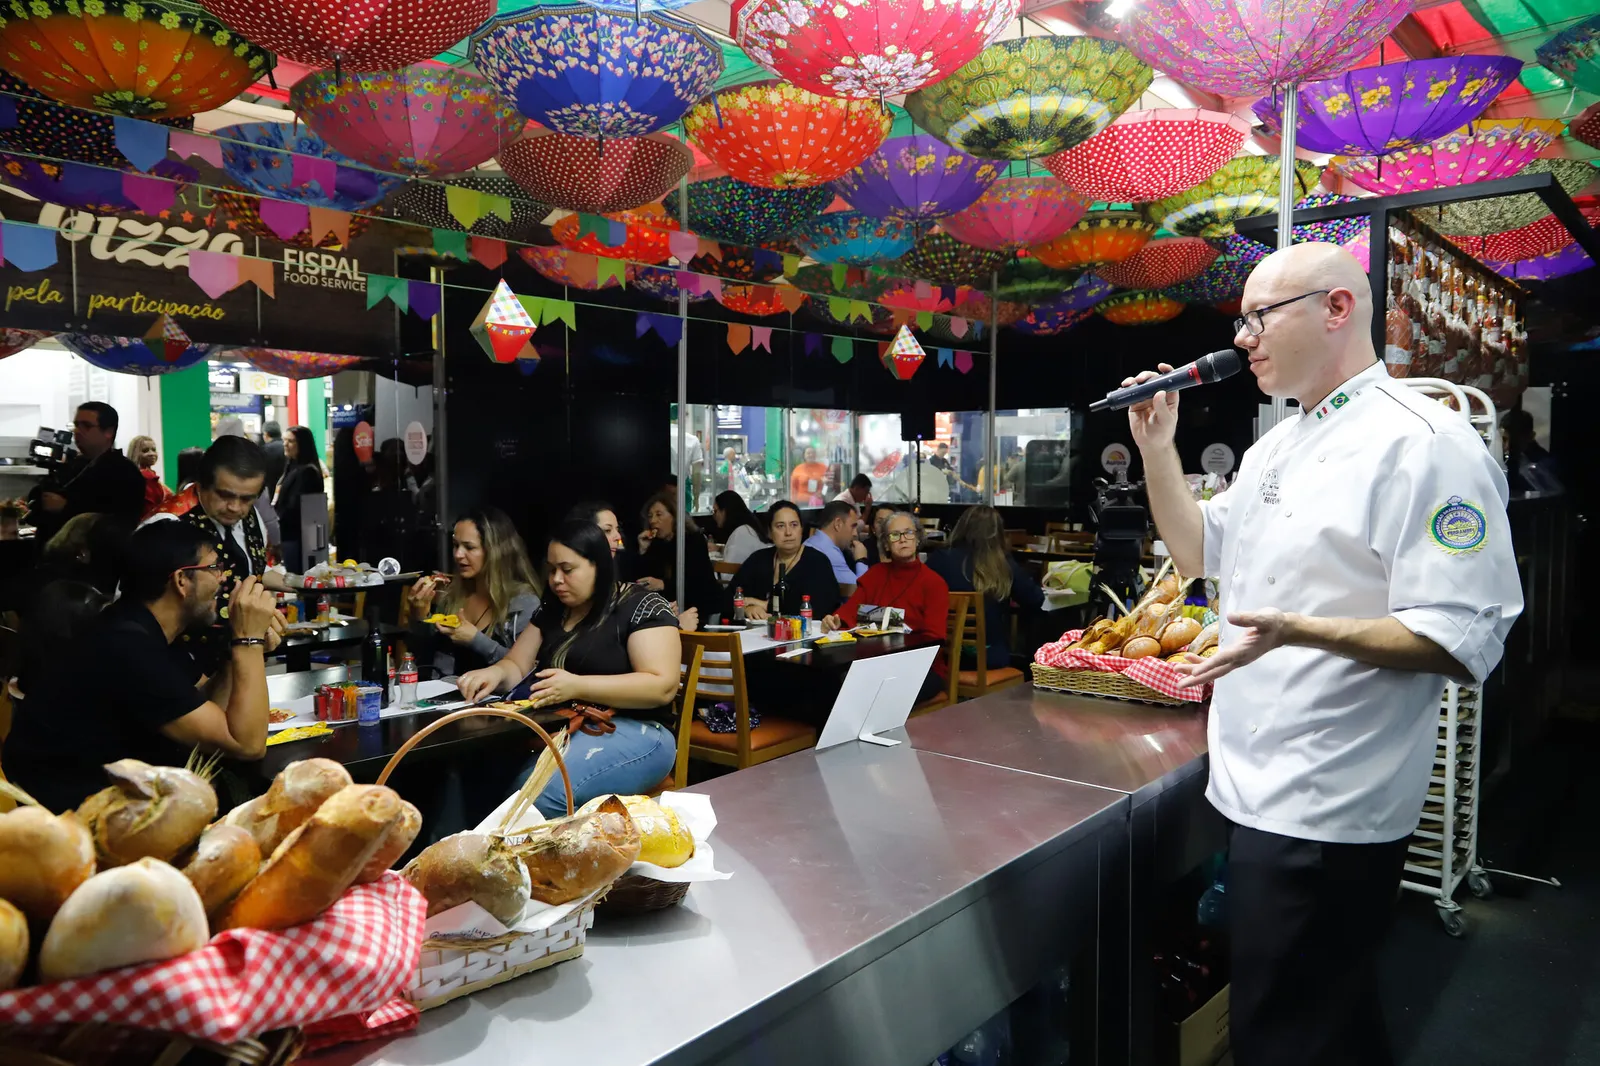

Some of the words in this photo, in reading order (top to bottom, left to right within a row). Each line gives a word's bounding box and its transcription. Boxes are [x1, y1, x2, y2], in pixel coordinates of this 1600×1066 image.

[283, 247, 367, 282] FISPAL
[283, 272, 318, 286] FOOD
[321, 277, 367, 292] SERVICE
[4, 279, 64, 312] pela
[87, 291, 226, 321] participação
